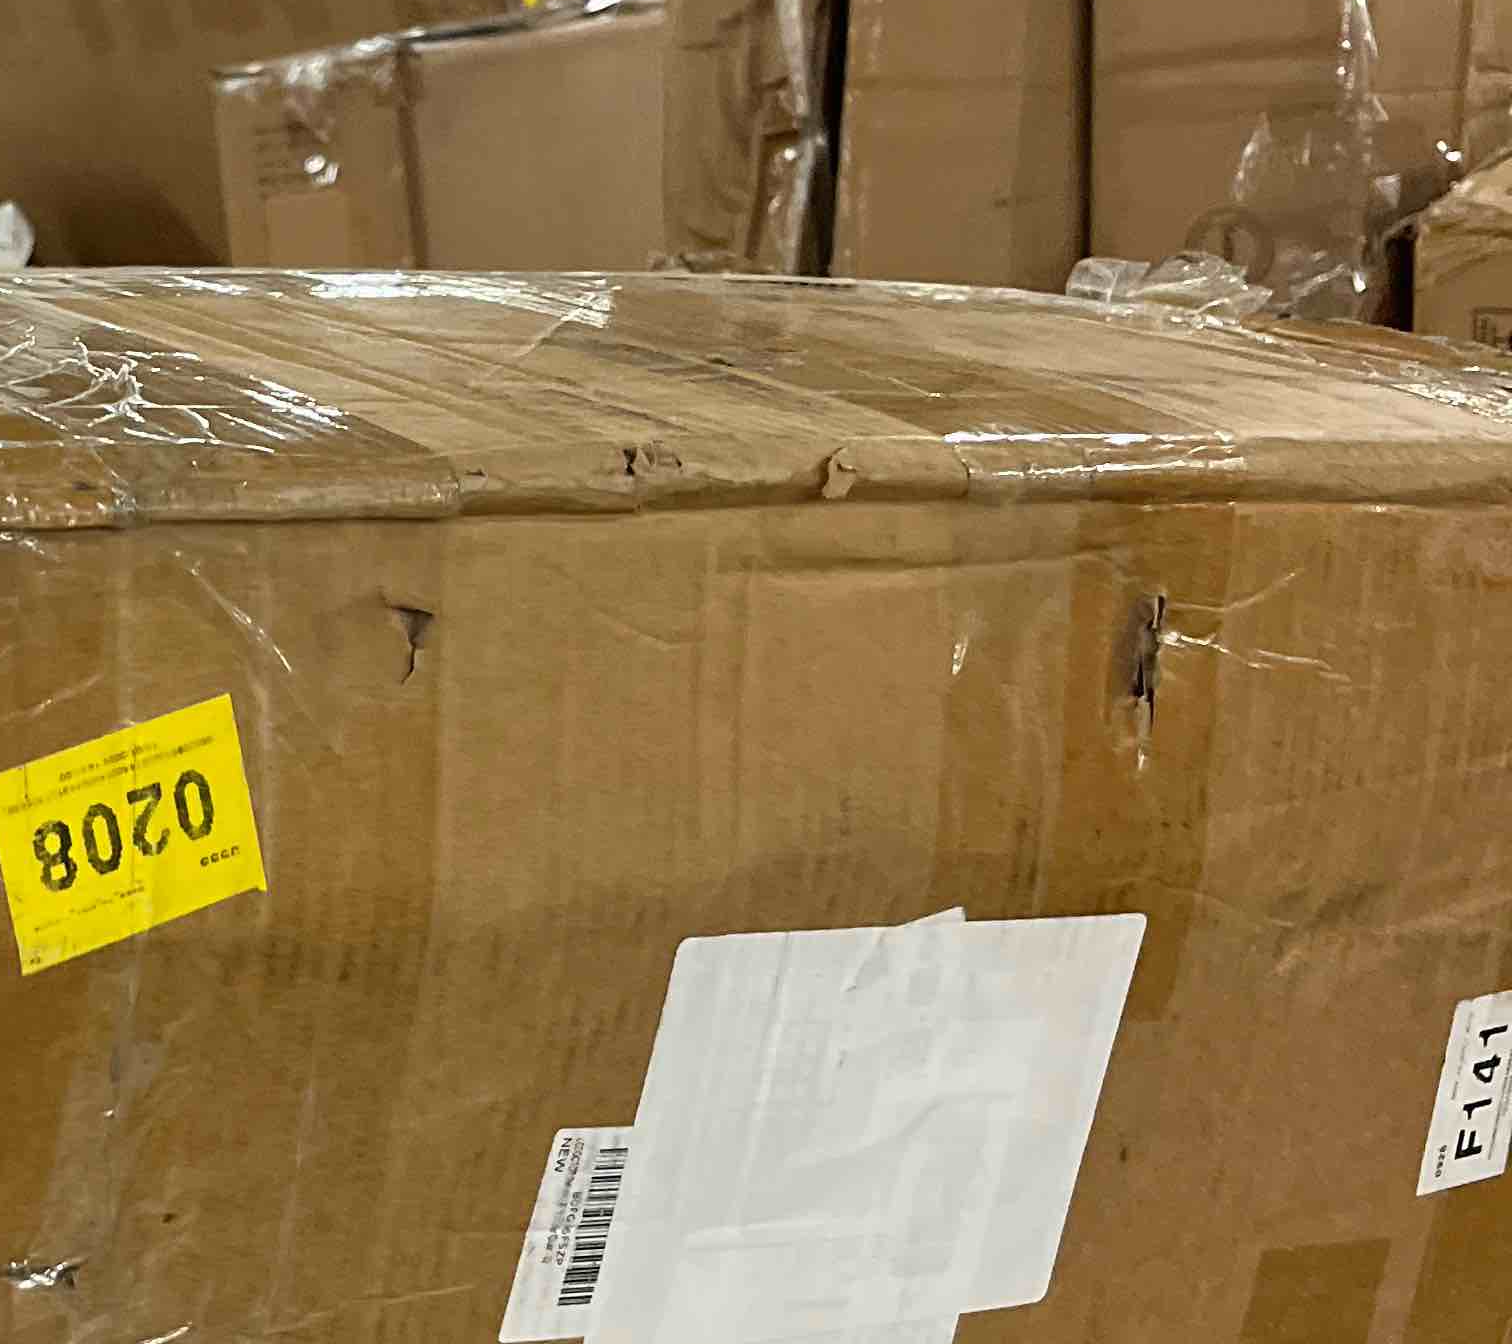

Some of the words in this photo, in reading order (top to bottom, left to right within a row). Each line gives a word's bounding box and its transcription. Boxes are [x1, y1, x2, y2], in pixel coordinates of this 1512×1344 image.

[33, 769, 215, 892] 0208
[1454, 1024, 1509, 1160] F141
[554, 1137, 573, 1173] NEW
